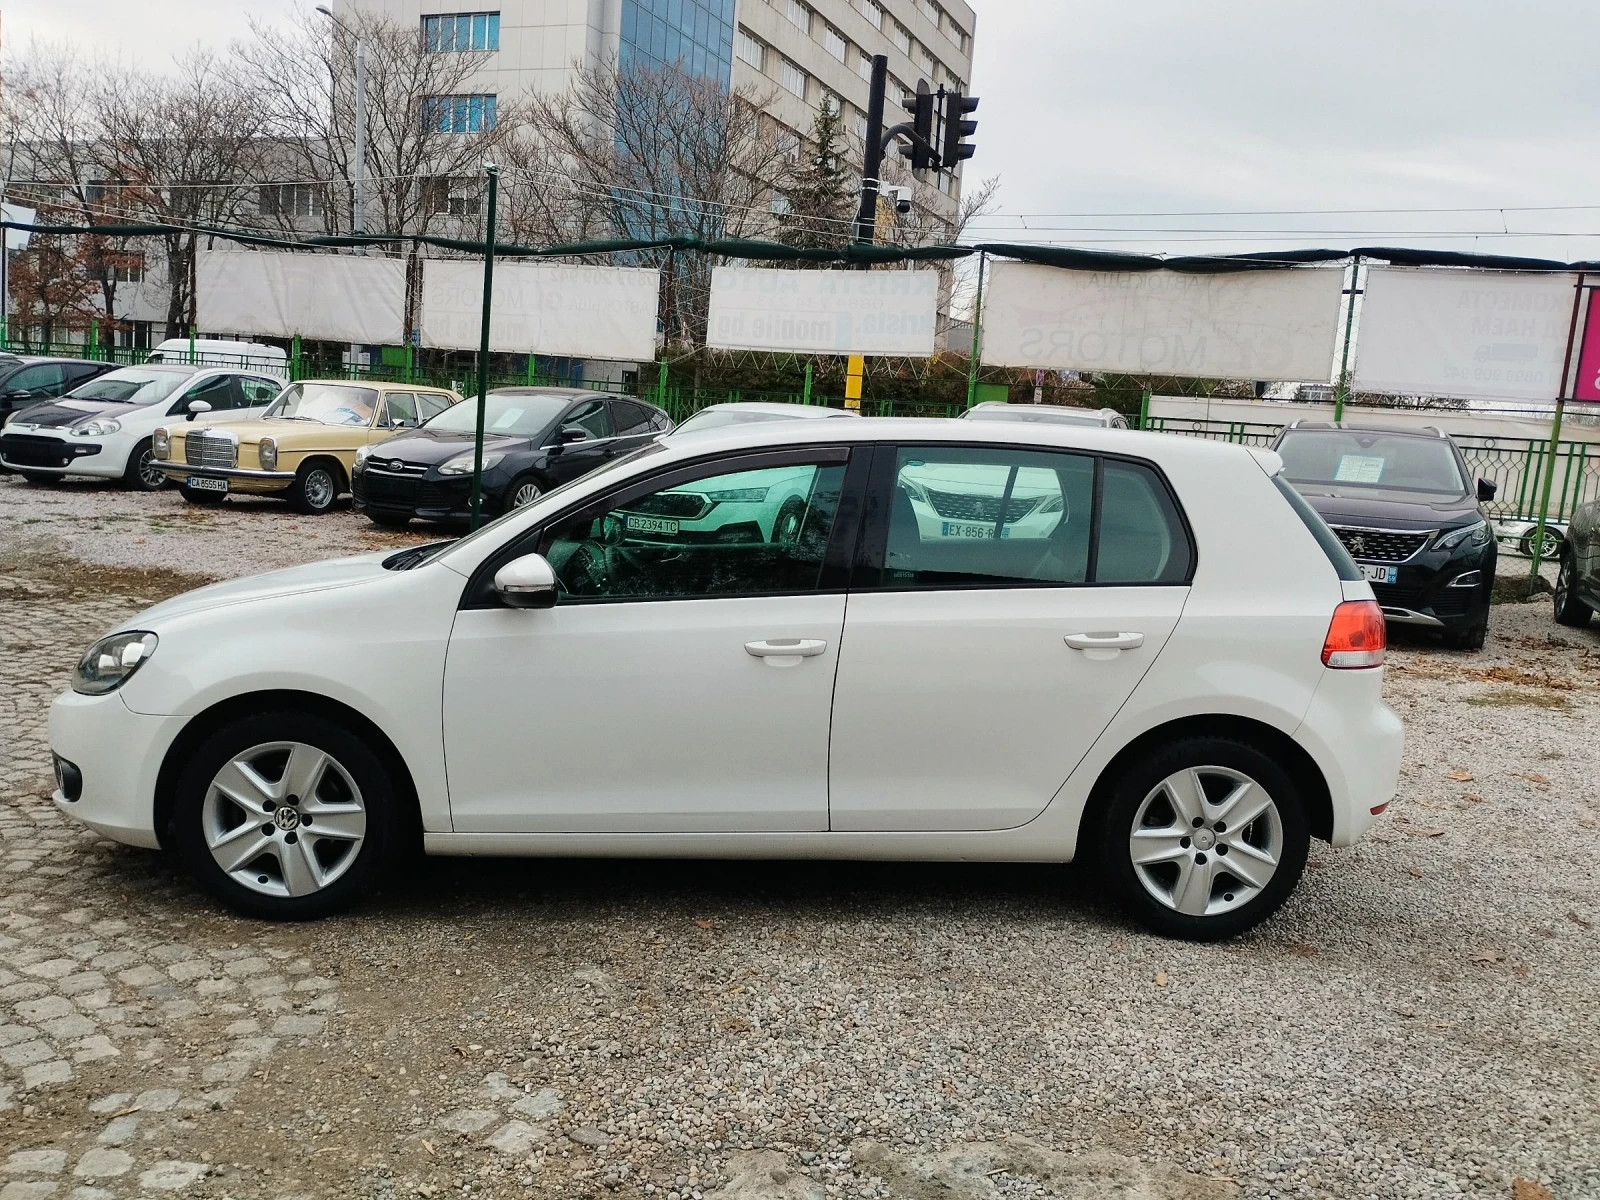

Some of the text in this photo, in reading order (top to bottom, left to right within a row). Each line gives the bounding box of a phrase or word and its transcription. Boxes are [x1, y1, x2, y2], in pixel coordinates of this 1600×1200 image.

[628, 517, 677, 531] CB 2394 TC
